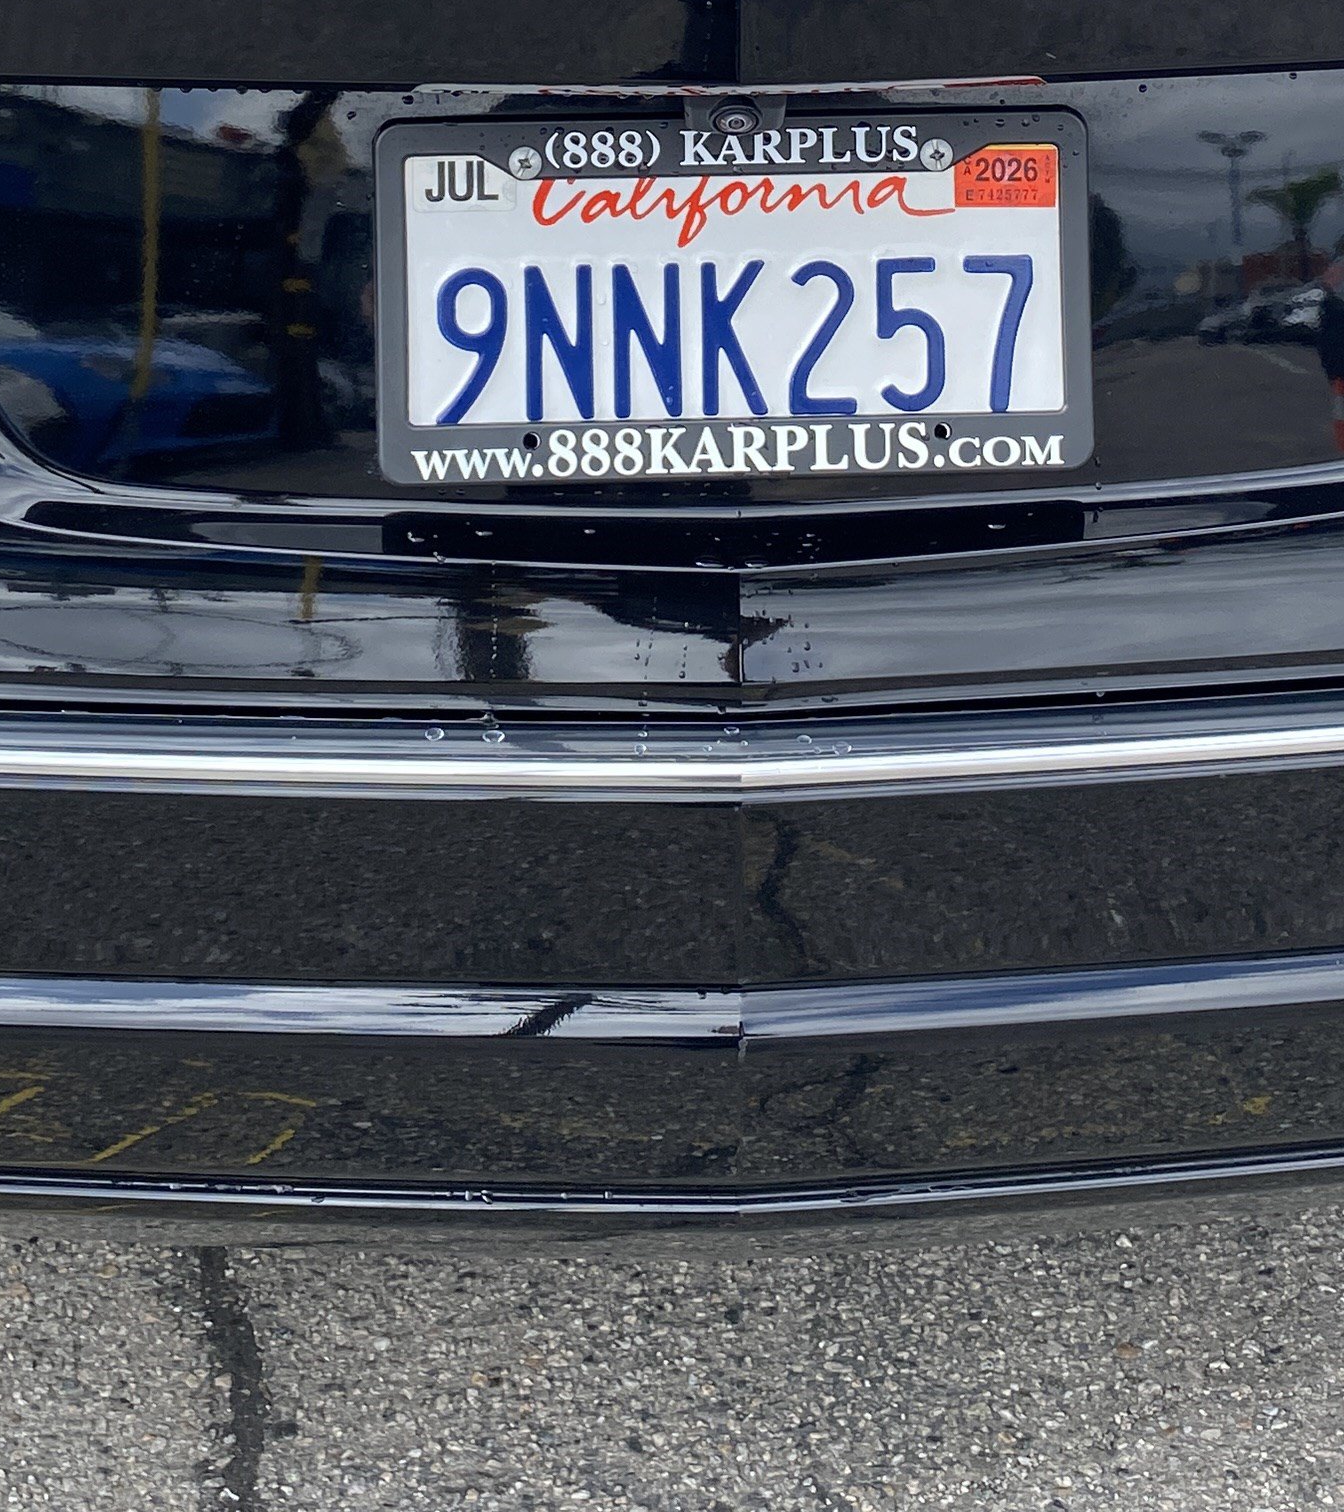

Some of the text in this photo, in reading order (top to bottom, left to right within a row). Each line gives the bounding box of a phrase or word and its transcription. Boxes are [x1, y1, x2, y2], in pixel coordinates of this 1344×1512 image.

[545, 125, 919, 169] (888) KARPLUS
[425, 161, 500, 203] JUL
[975, 157, 1038, 182] 2026
[532, 175, 956, 248] California
[435, 254, 1034, 426] 9NNK257
